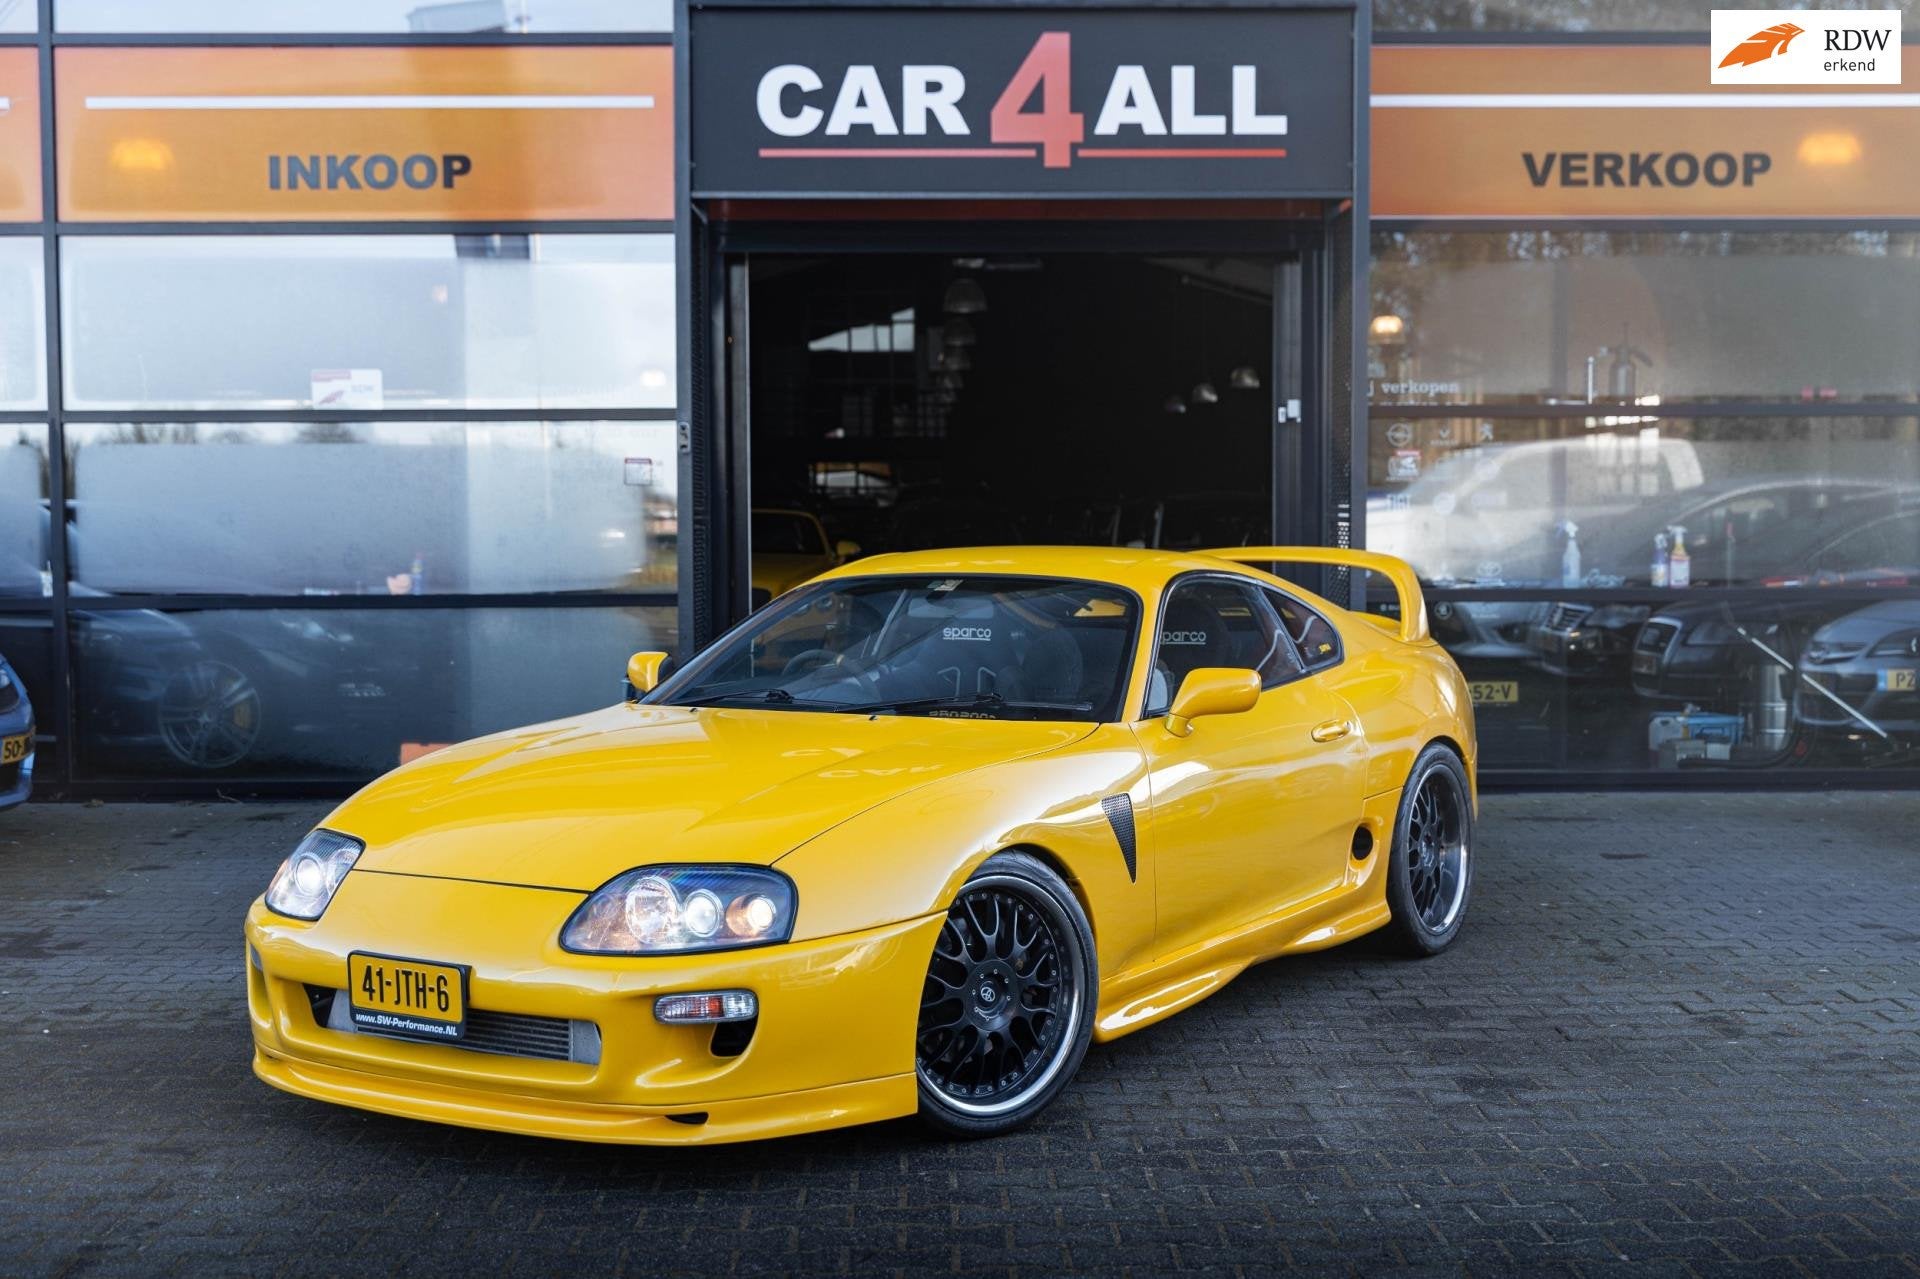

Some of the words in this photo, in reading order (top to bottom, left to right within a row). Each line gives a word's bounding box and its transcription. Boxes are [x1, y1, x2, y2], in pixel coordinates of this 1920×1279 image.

[756, 64, 970, 137] CAR
[990, 32, 1084, 168] 4
[1094, 65, 1288, 136] ALL
[268, 154, 471, 191] INKOOP
[1521, 152, 1771, 187] VERKOOP
[942, 627, 992, 641] sparco
[1160, 631, 1206, 645] parco
[362, 965, 449, 1013] 41-JTH-6
[355, 1013, 458, 1036] www.SW-Performance.NL
